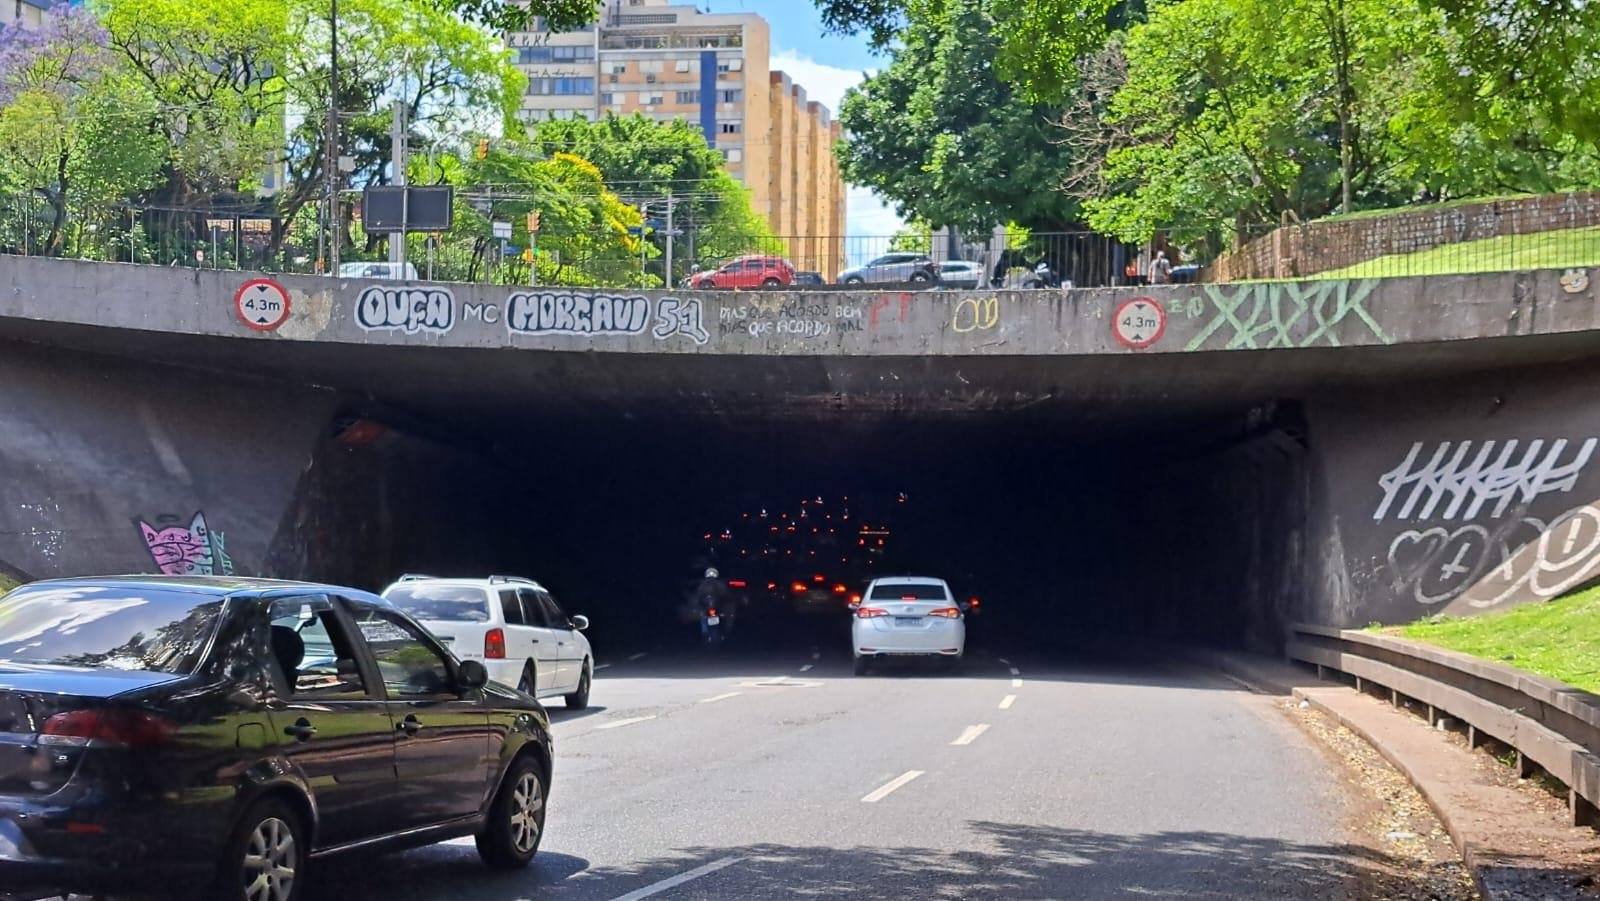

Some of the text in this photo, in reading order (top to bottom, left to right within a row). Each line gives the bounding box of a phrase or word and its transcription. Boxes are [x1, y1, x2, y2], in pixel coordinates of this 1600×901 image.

[463, 301, 498, 323] MC
[652, 297, 710, 344] 51
[835, 305, 863, 318] BEM
[748, 321, 774, 338] QUE
[776, 319, 832, 338] ACORDO
